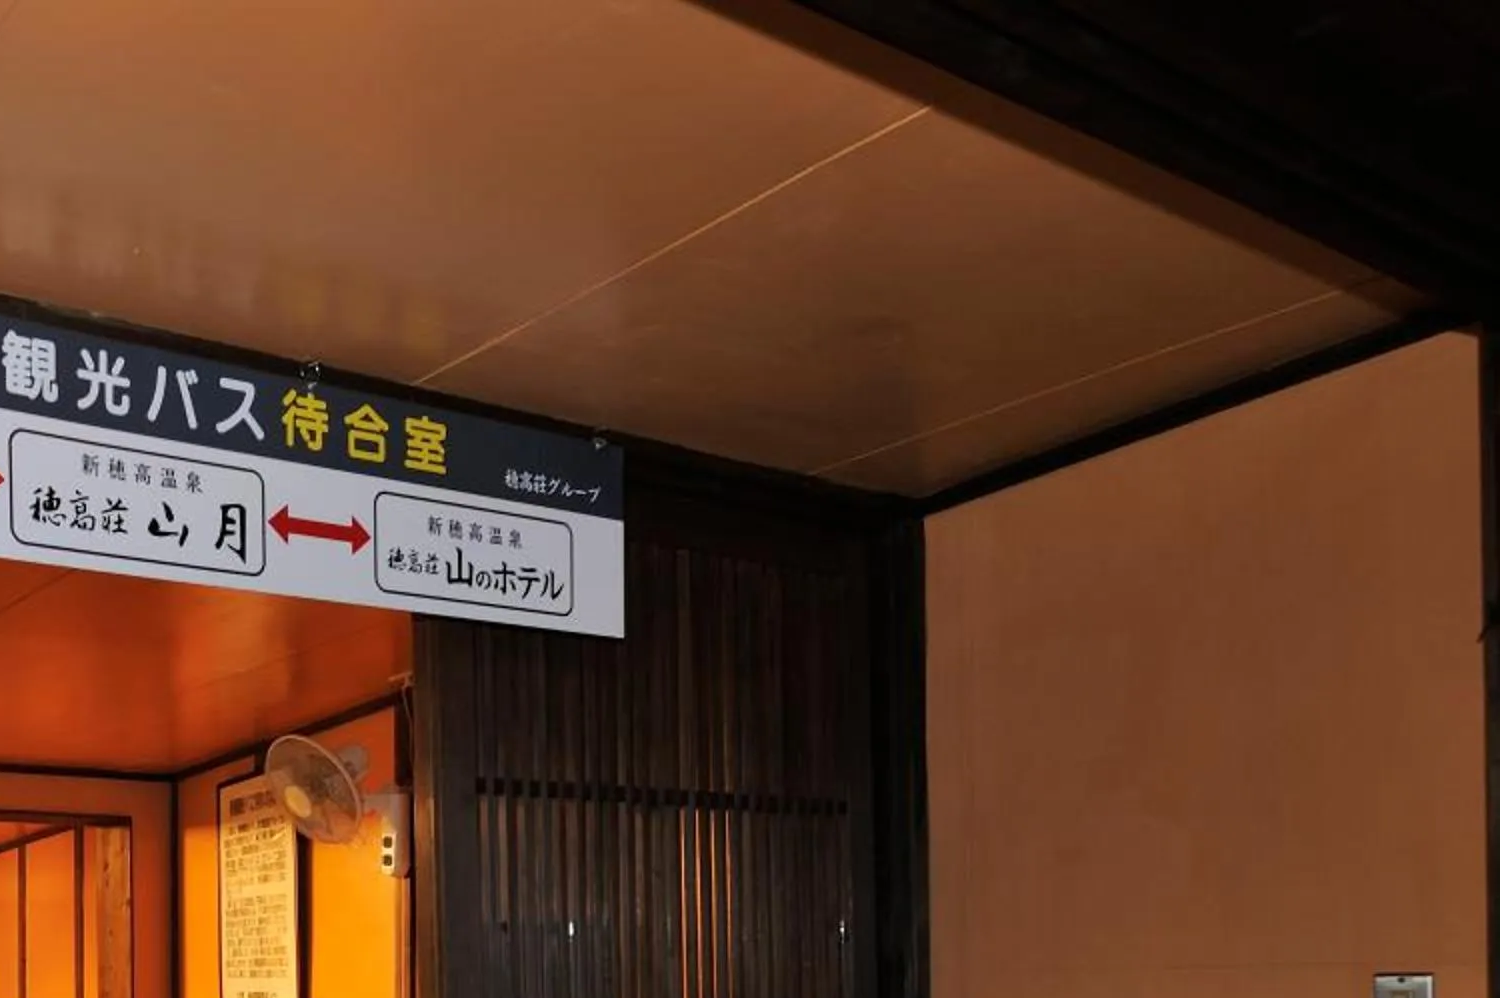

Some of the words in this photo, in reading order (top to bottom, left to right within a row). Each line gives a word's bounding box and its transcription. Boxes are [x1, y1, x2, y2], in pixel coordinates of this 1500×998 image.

[82, 453, 204, 494] 新穂高温泉
[428, 515, 523, 549] 新穂高温泉
